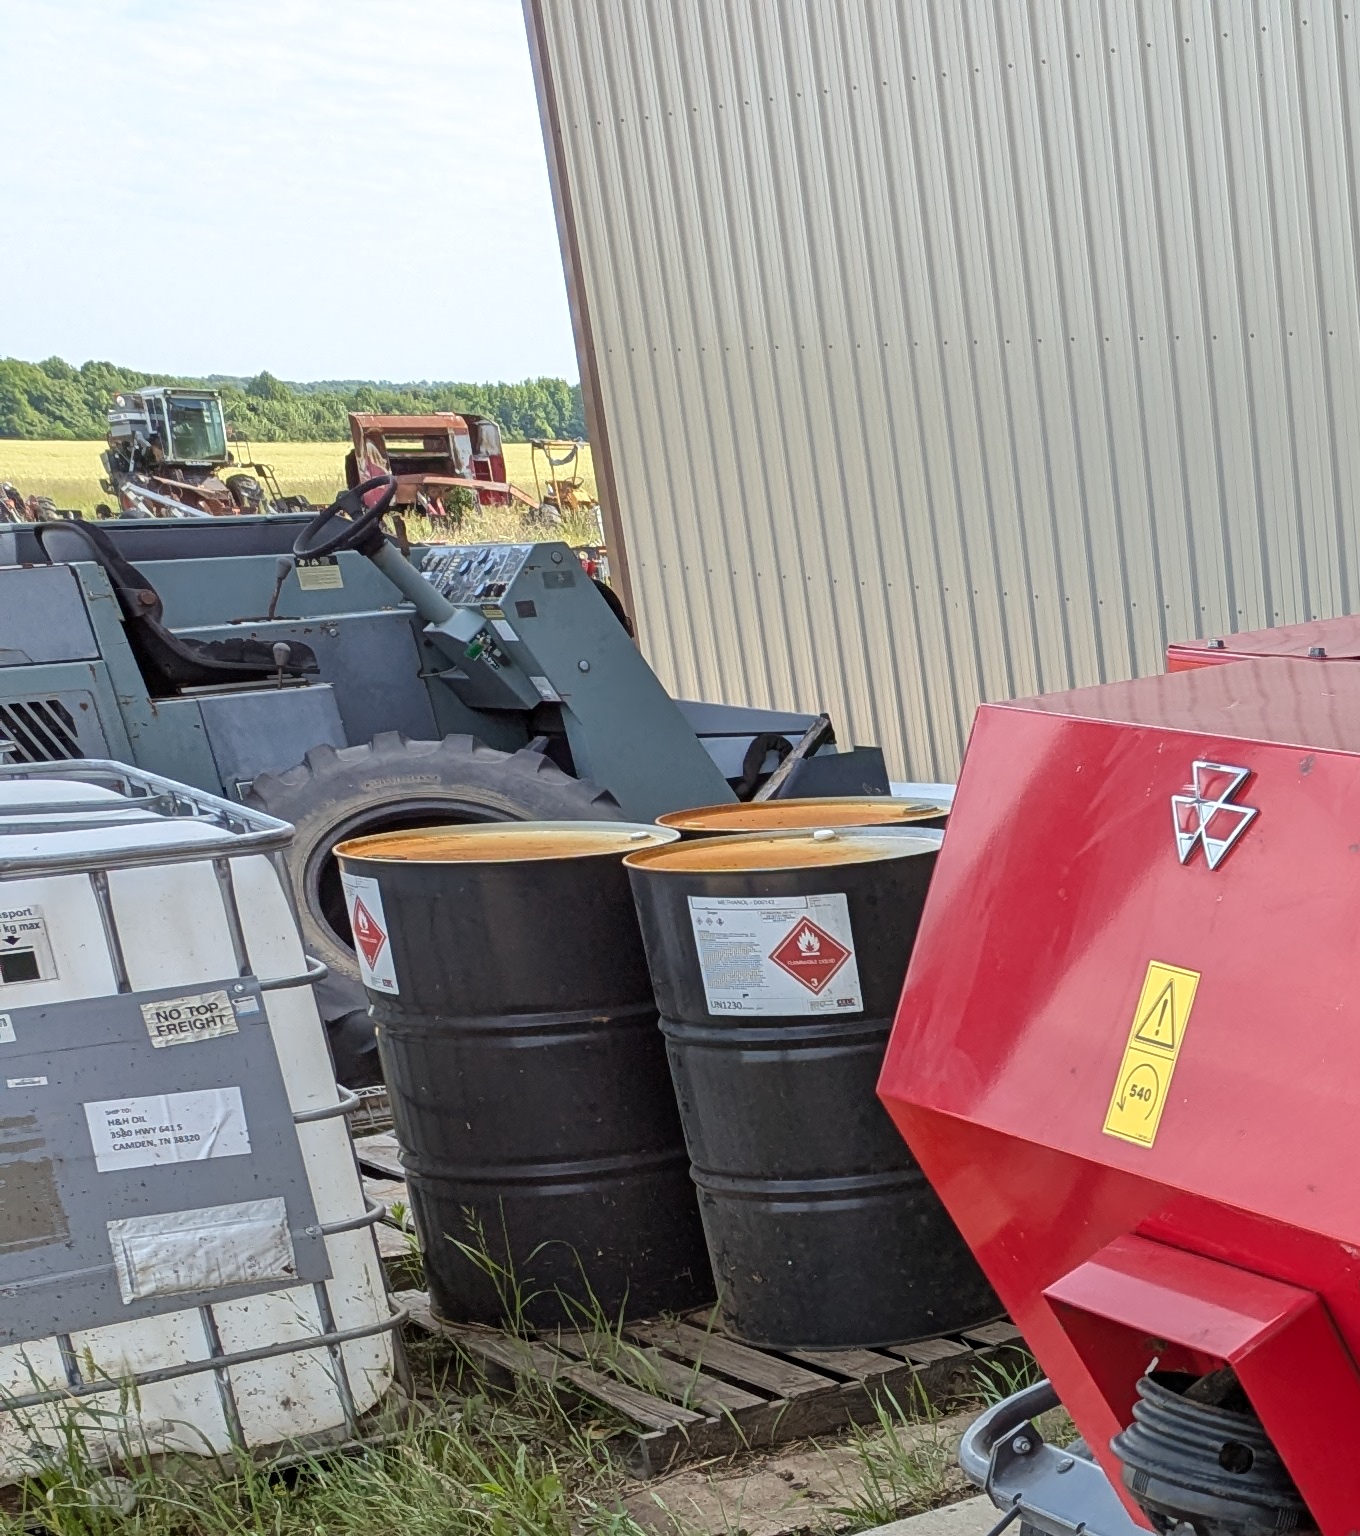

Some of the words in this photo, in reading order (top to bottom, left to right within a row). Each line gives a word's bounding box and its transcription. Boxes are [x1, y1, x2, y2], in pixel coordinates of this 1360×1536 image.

[0, 908, 33, 920] sport
[3, 924, 17, 935] kg
[19, 921, 41, 932] max
[811, 978, 818, 987] 3
[710, 1001, 742, 1009] UN1230
[156, 1008, 181, 1024] NO
[185, 1002, 219, 1018] TOP
[156, 1014, 226, 1037] FREIGHT
[1129, 1084, 1152, 1103] 540
[107, 1118, 129, 1126] H&H
[135, 1127, 157, 1136] HWY
[159, 1124, 175, 1133] 641
[113, 1140, 157, 1151] CAMDEN,
[158, 1137, 171, 1146] TN
